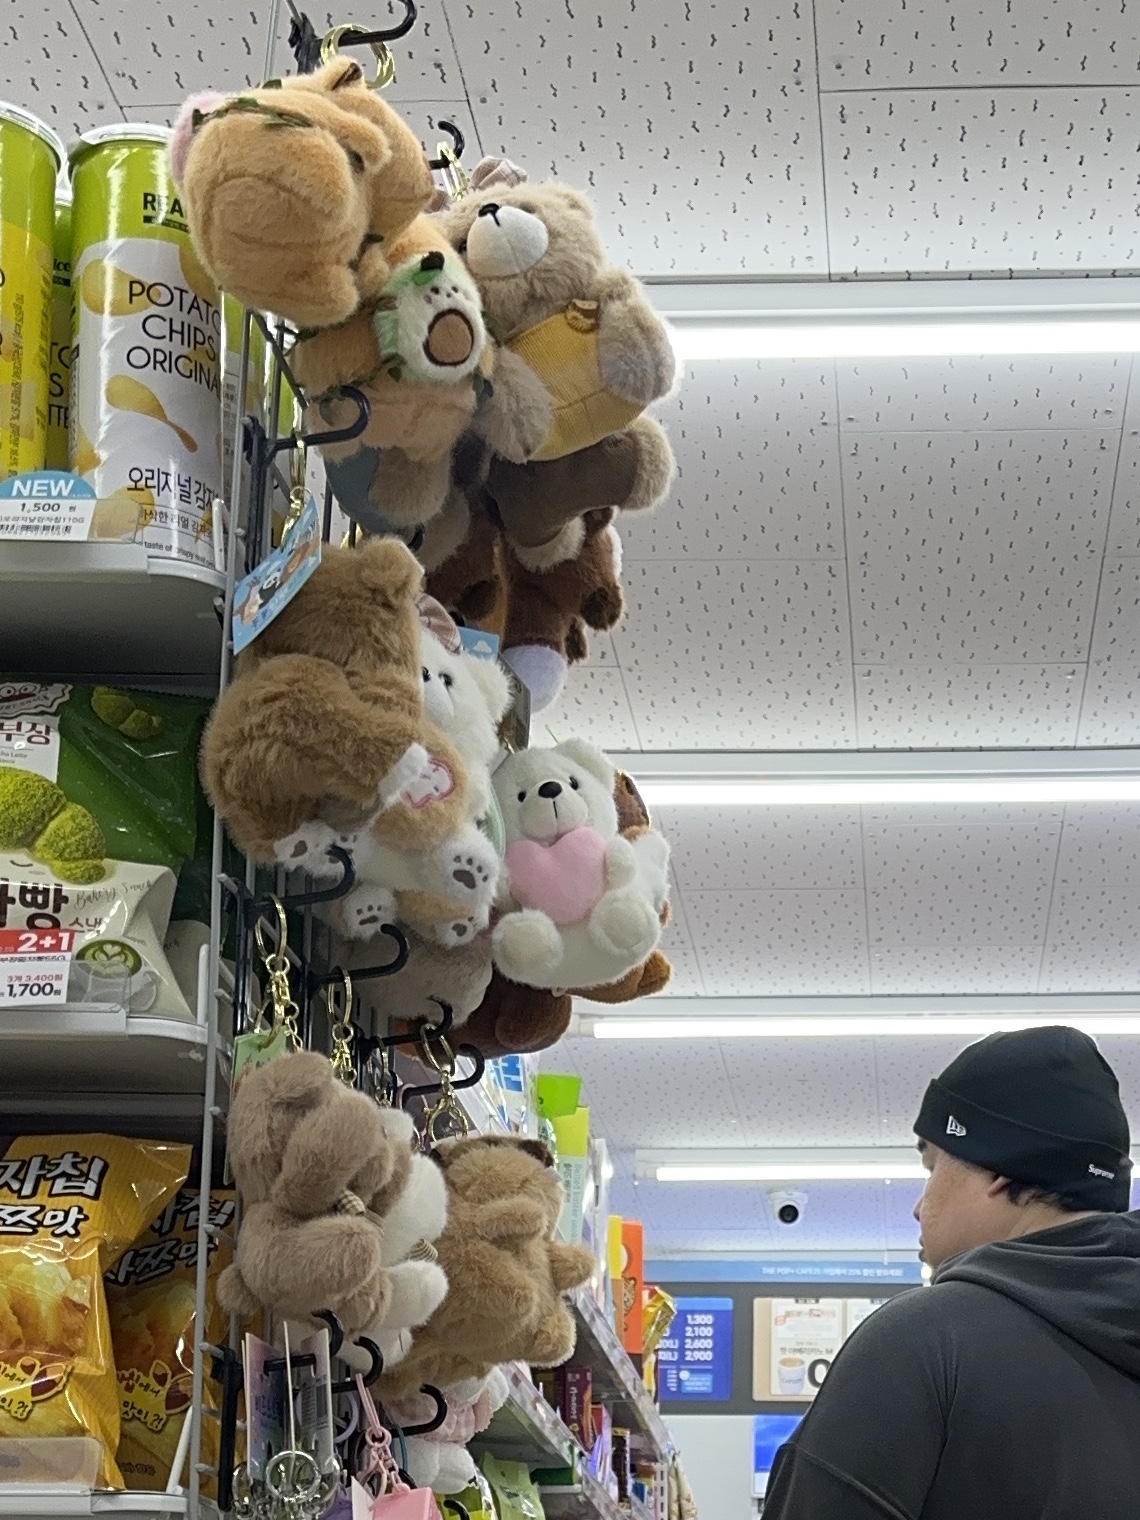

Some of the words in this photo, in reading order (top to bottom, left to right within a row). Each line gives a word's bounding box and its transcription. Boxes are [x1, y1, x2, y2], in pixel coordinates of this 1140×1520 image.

[143, 192, 186, 219] REA
[142, 314, 217, 362] CHIPS
[126, 345, 222, 400] ORIGINA
[11, 479, 75, 497] NEW
[127, 466, 192, 505] 오리지널
[193, 479, 219, 511] 감자
[20, 502, 61, 514] 1,500
[17, 932, 70, 952] 2+1
[0, 1152, 108, 1200] 자칩
[1088, 1163, 1115, 1180] Supreme
[685, 1326, 713, 1337] 2,100
[685, 1338, 713, 1349] 2,600
[685, 1350, 713, 1362] 2,900
